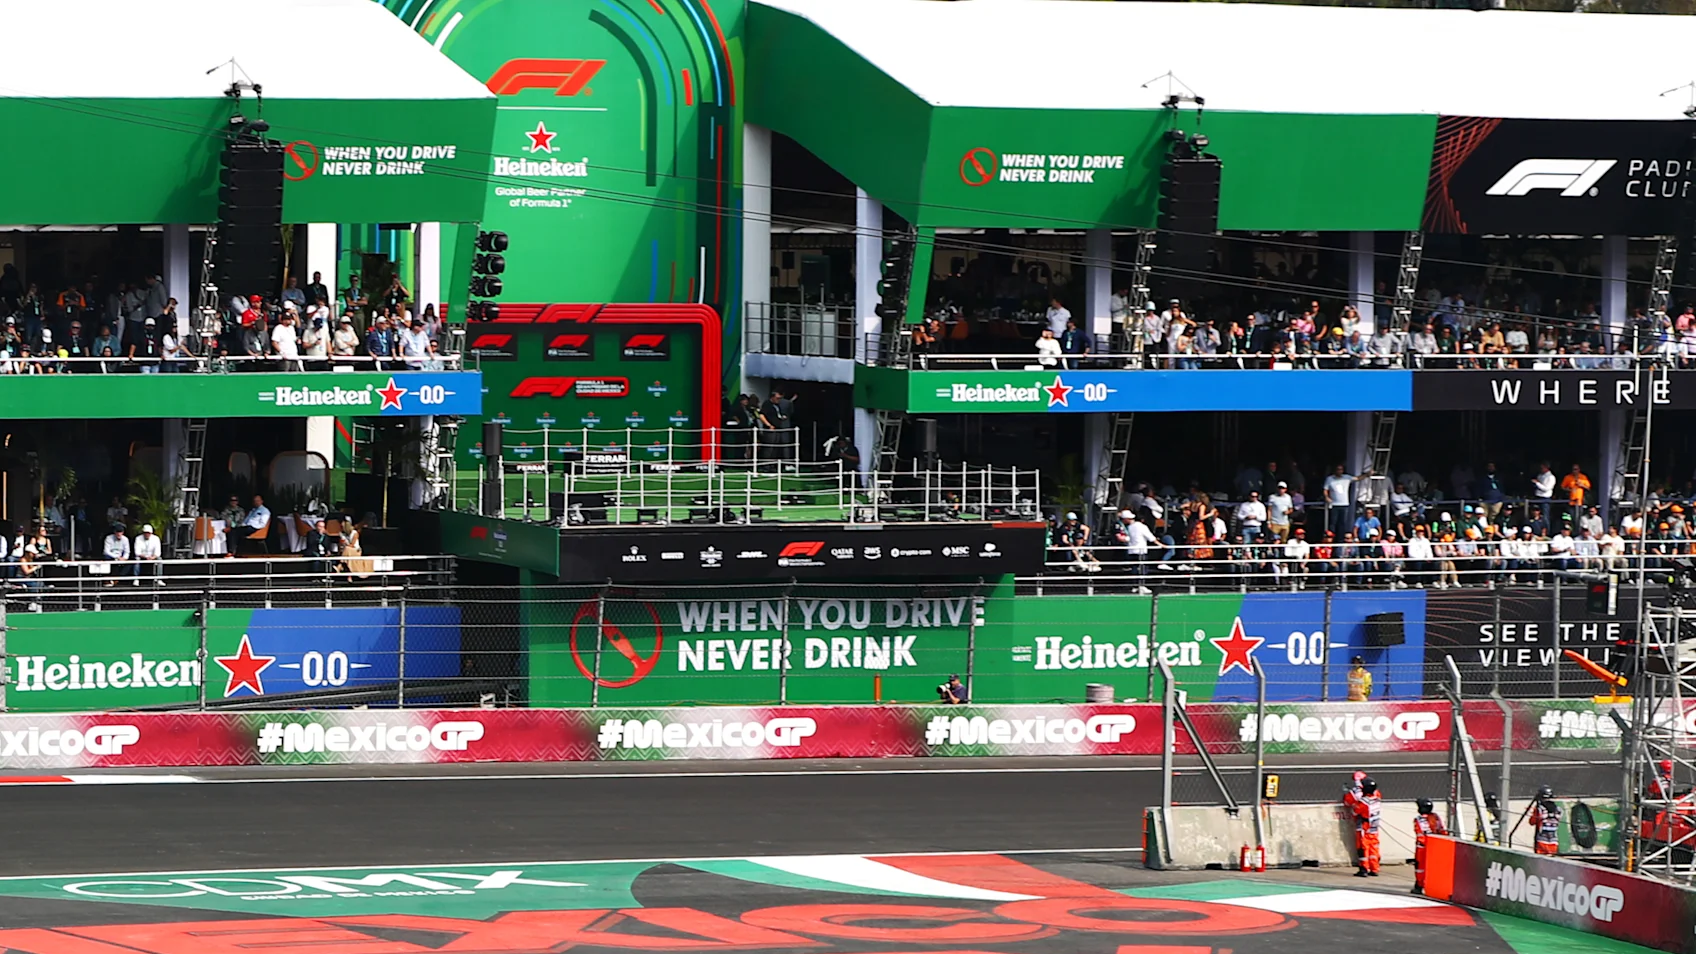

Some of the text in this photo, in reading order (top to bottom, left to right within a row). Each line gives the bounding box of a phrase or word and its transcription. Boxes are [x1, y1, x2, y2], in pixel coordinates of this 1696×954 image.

[324, 146, 456, 160] WHEN YOU DRIVE
[1001, 154, 1124, 169] WHEN YOU DRIVE
[322, 161, 425, 175] NEVER DRINK
[999, 169, 1095, 183] NEVER DRINK
[495, 187, 526, 196] Global
[527, 187, 549, 197] Beer
[521, 198, 561, 208] Formula
[1491, 379, 1671, 404] WHERE
[831, 547, 854, 555] QATAR
[677, 597, 986, 633] WHEN YOU DRIVE
[1479, 622, 1621, 643] SEE THE
[677, 635, 918, 671] NEVER DRINK
[257, 720, 485, 753] #MexicoGP
[597, 717, 817, 749] #MexicoGP
[924, 713, 1136, 746] #MexicoGP
[1239, 711, 1440, 742] #MexicoGP
[1486, 862, 1624, 922] #MexicoGP
